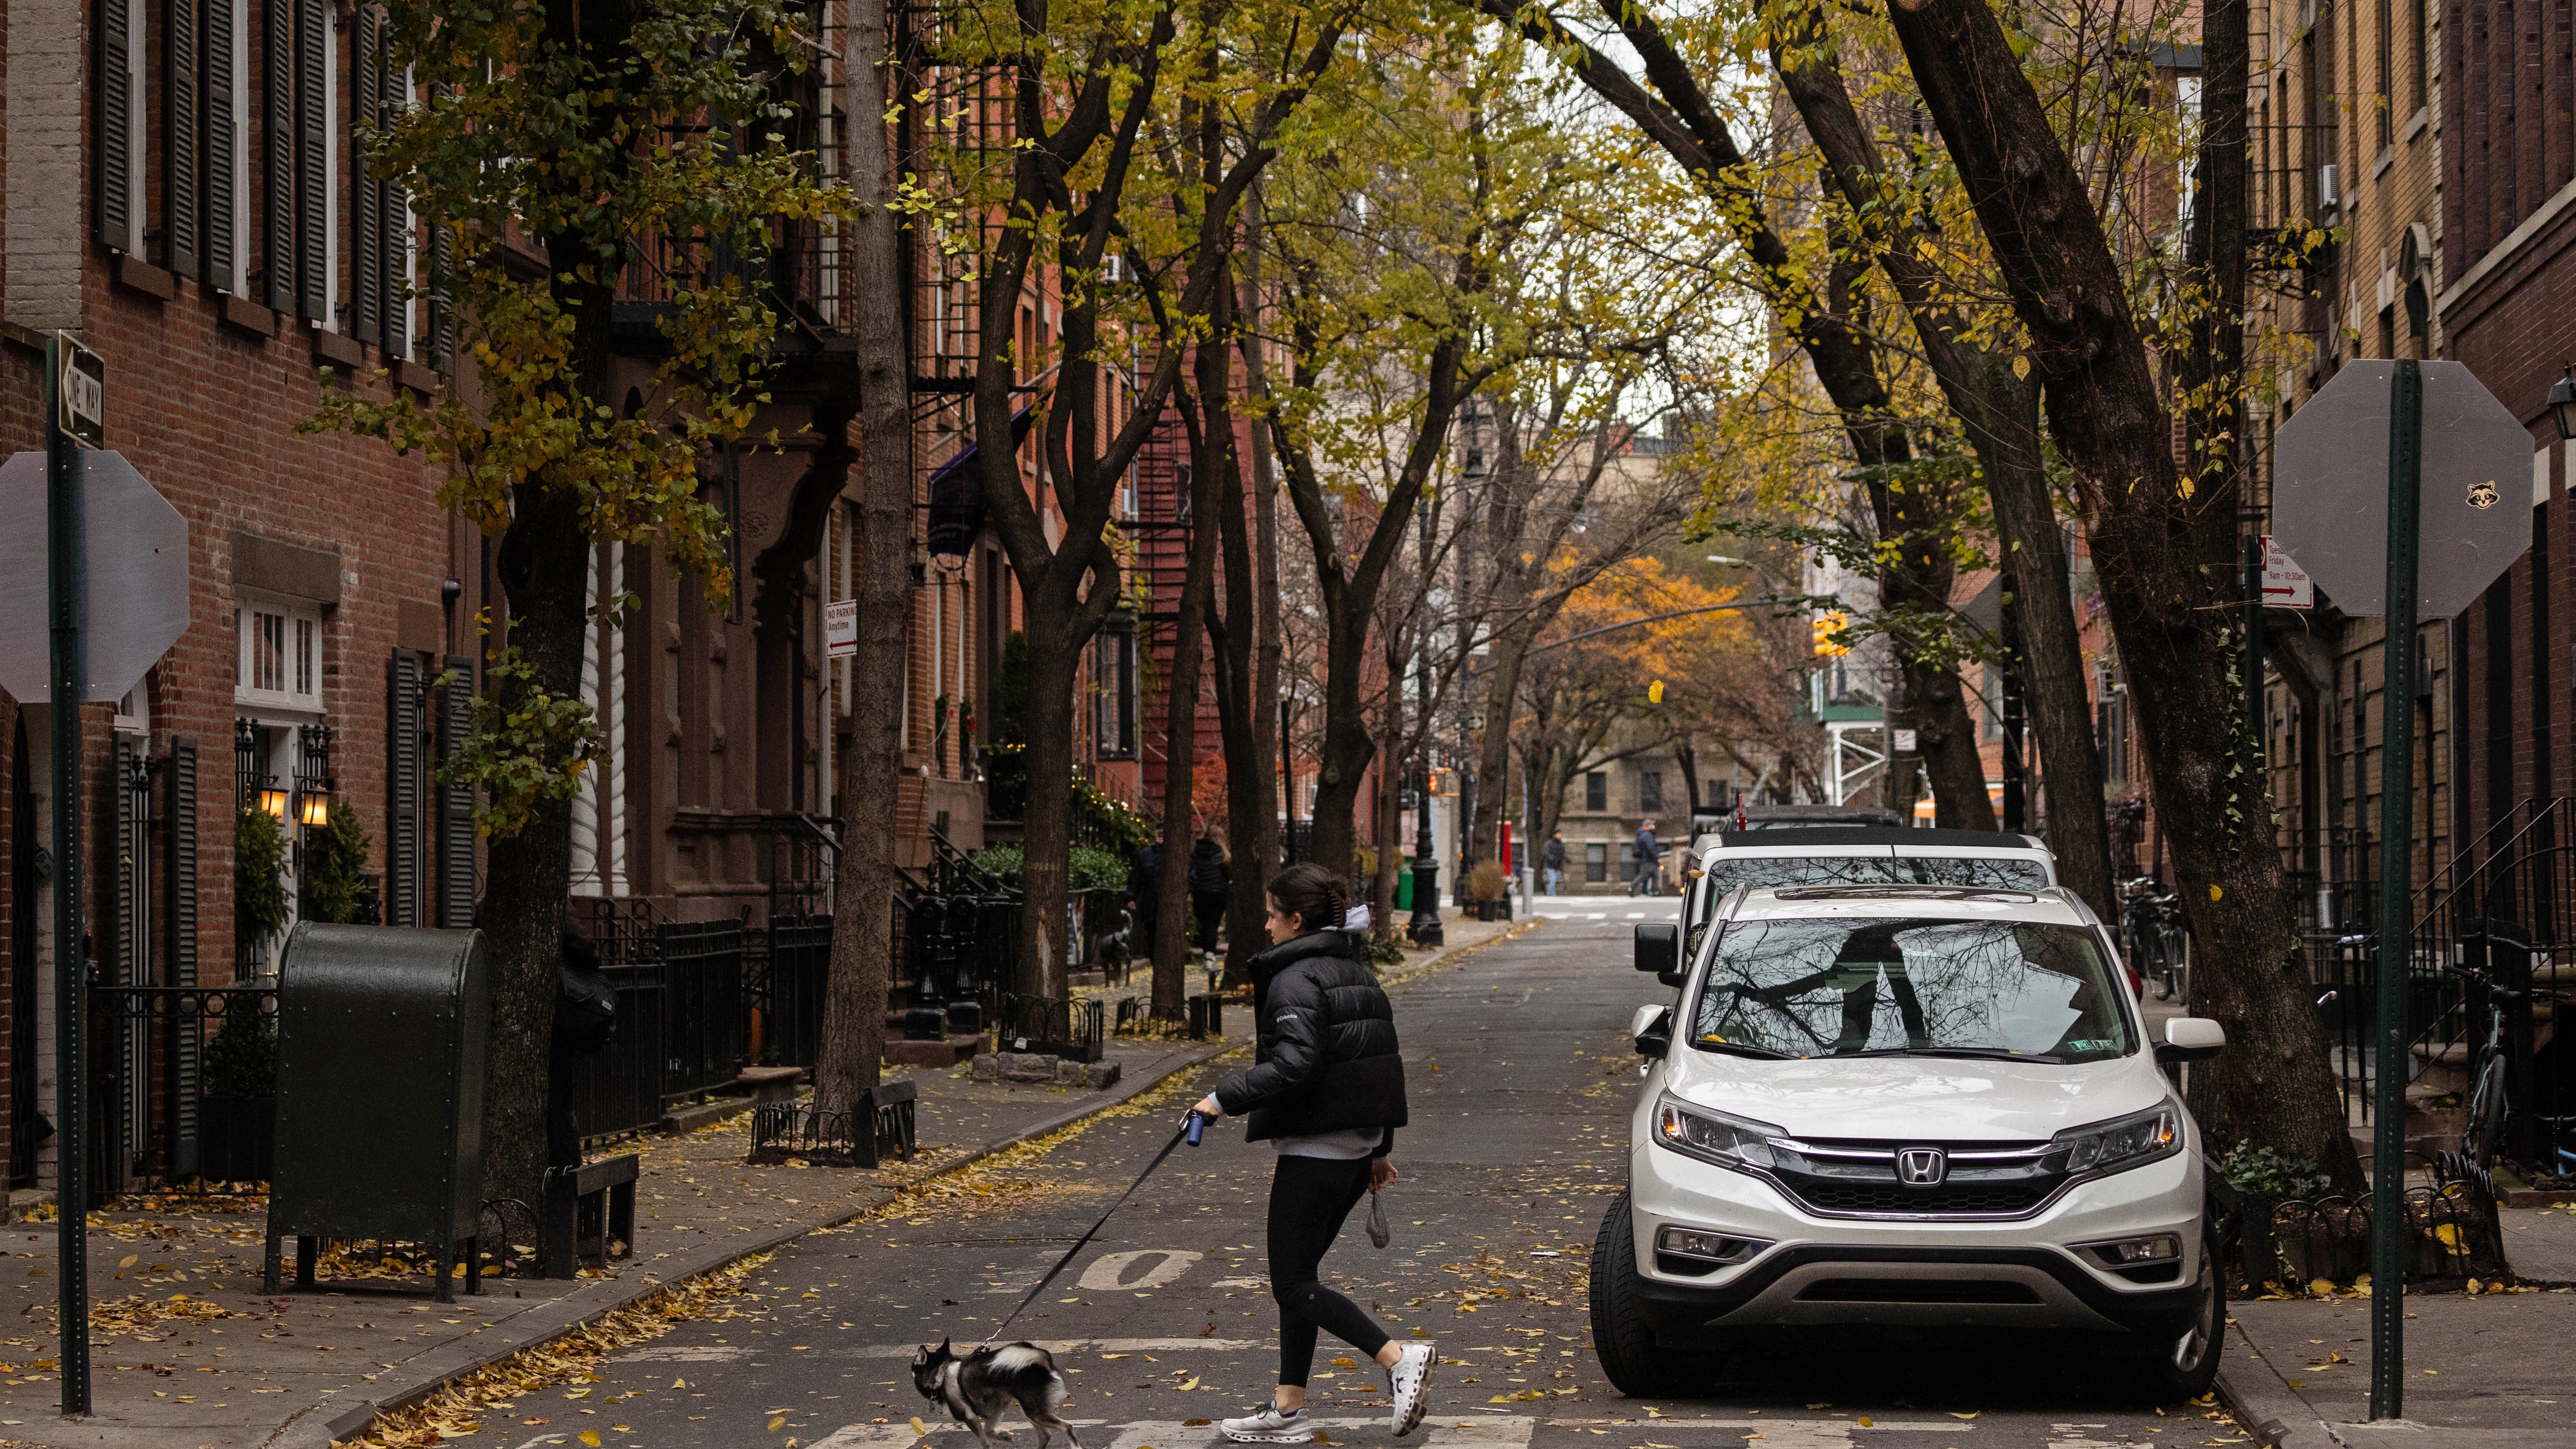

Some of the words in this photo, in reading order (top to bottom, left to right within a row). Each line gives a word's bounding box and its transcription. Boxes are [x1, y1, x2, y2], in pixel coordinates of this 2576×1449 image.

[68, 368, 80, 409] ONE
[86, 380, 99, 419] WAY
[2269, 556, 2284, 566] Friday
[2269, 571, 2280, 580] 9am
[2285, 572, 2306, 580] 10:30am
[828, 609, 835, 619] NO
[829, 620, 849, 632] Anytime
